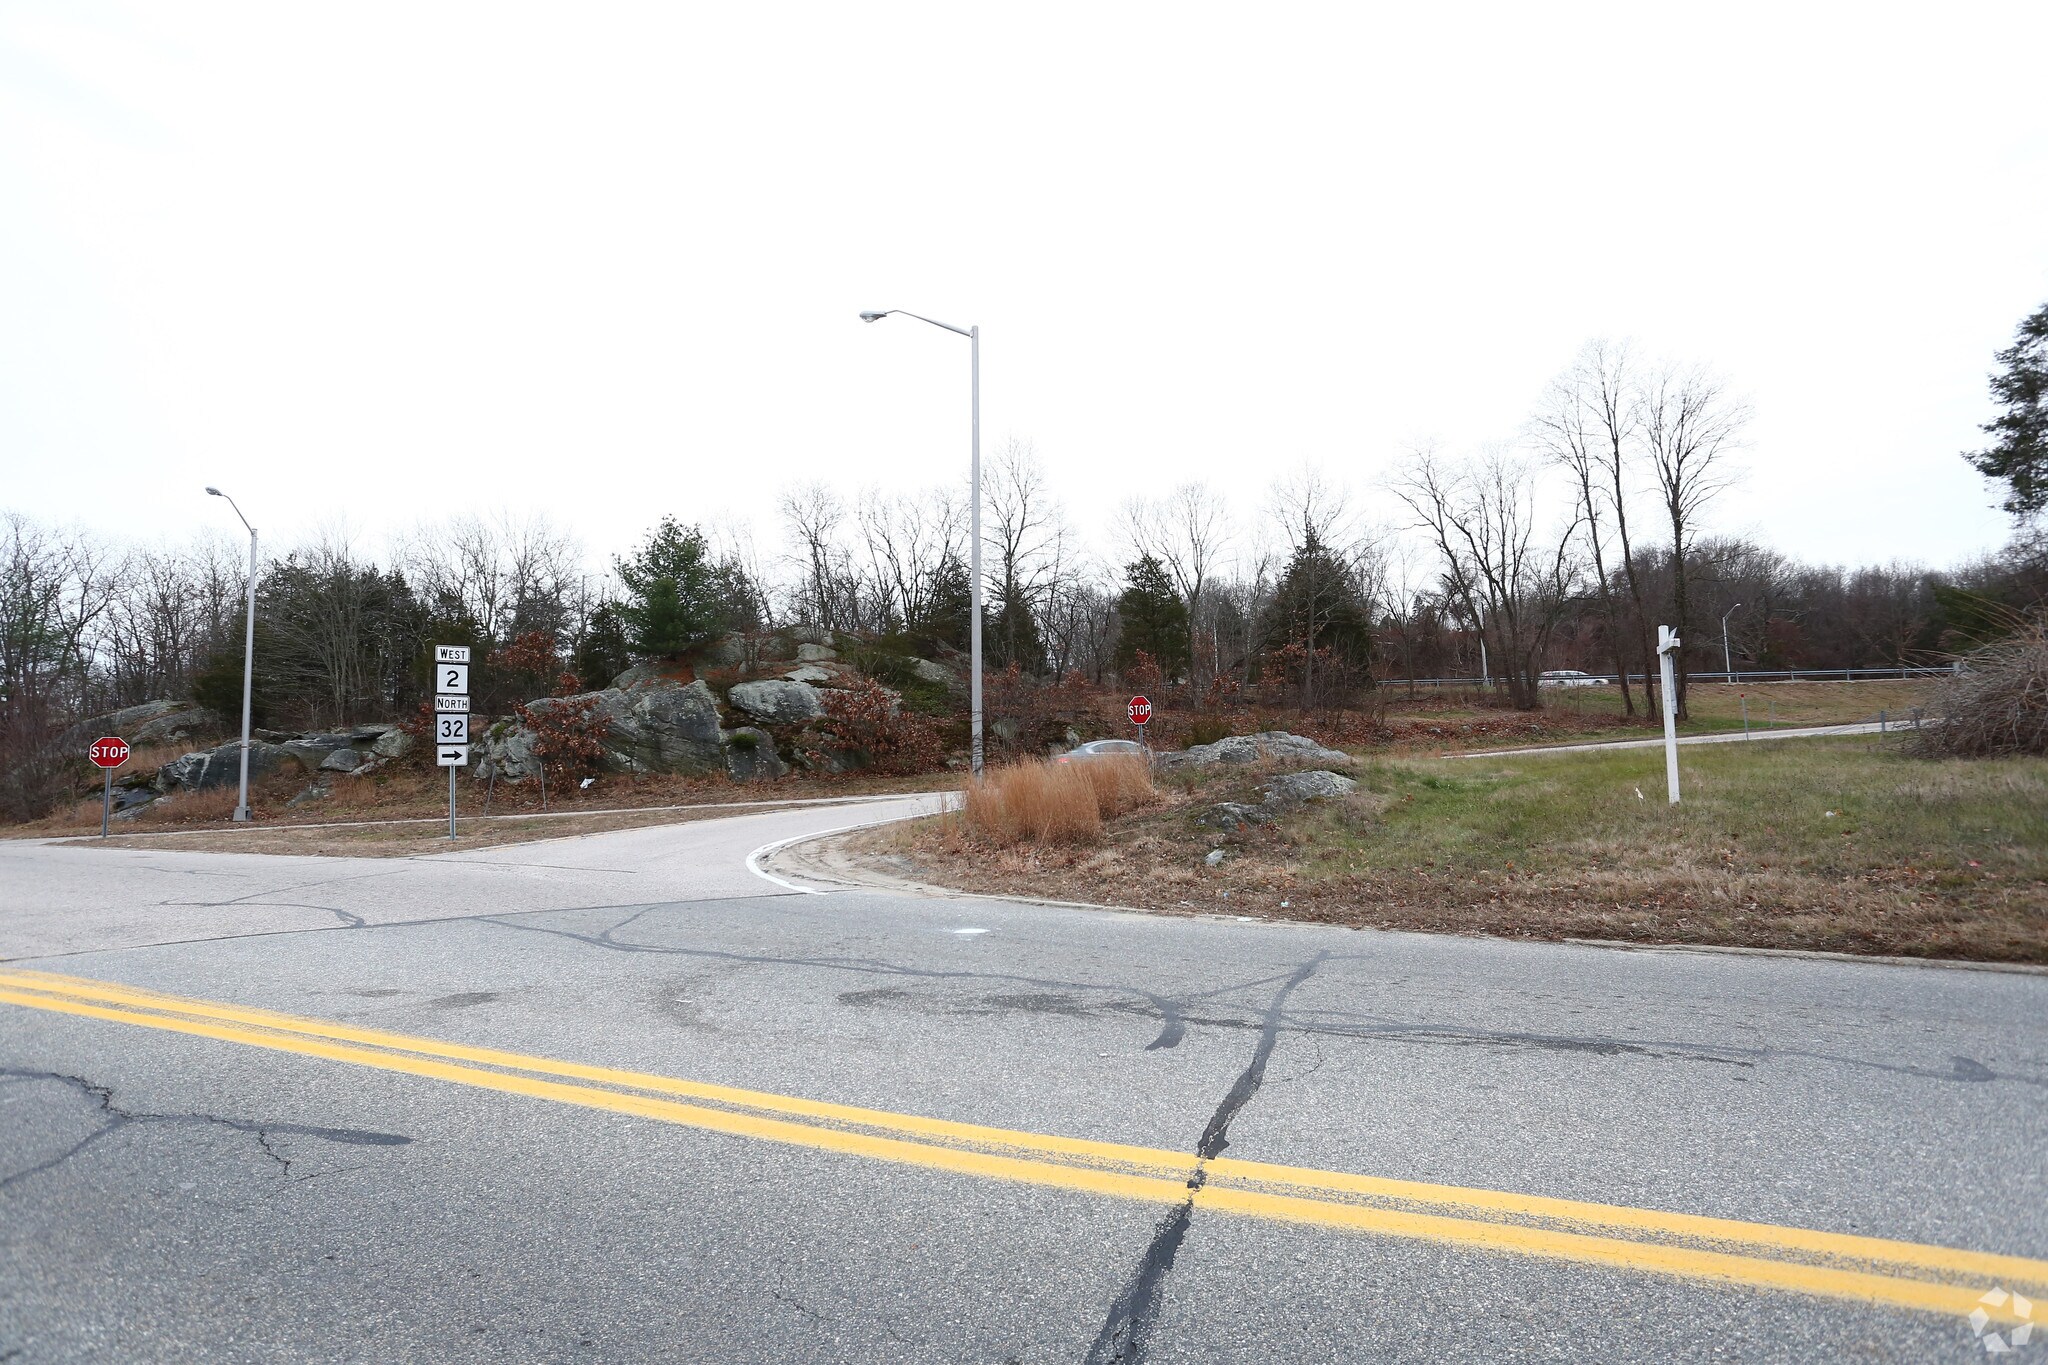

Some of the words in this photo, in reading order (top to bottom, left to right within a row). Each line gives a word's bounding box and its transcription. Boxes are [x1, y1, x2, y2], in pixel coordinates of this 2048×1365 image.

[440, 648, 466, 660] WEST
[446, 670, 459, 687] 2
[437, 698, 468, 709] NORTH
[1129, 704, 1151, 716] STOP
[441, 720, 464, 738] 32
[91, 746, 128, 758] STOP
